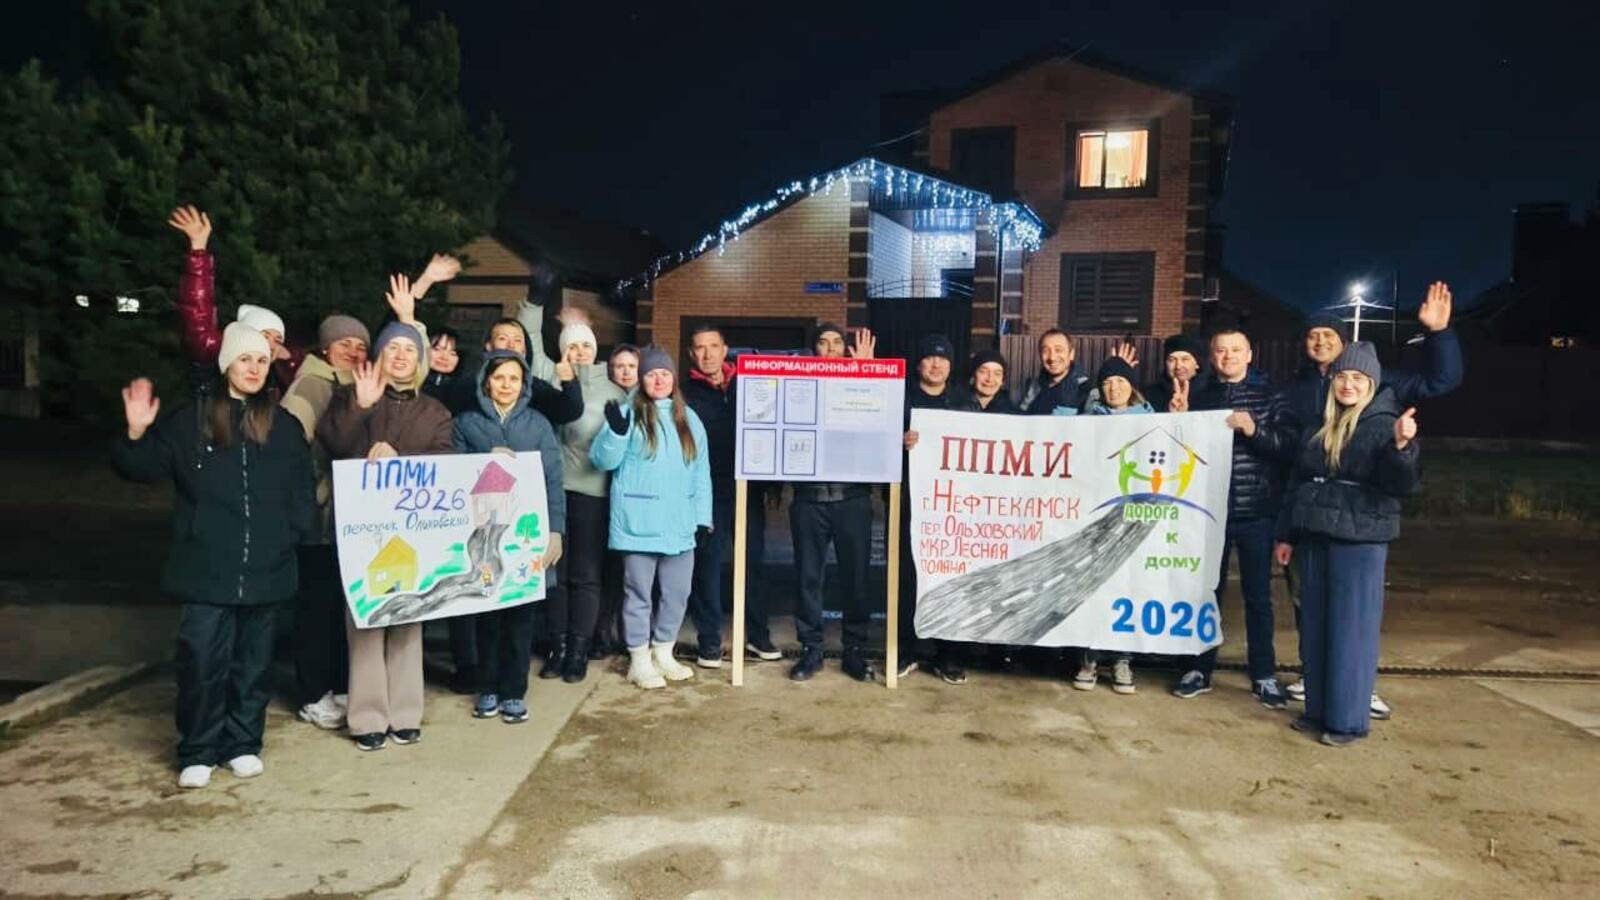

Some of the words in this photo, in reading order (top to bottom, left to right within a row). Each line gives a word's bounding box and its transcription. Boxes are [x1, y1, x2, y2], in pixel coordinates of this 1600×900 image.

[744, 359, 859, 373] ИНФОРМАЦИОННЫЙ
[861, 362, 898, 375] СТЕНД
[939, 435, 1073, 479] ППМИ
[362, 459, 437, 490] ППМИ
[394, 488, 466, 511] 2026
[1125, 504, 1179, 522] дорога
[1166, 532, 1178, 543] к
[1145, 556, 1200, 572] дому
[1112, 598, 1217, 643] 2026
